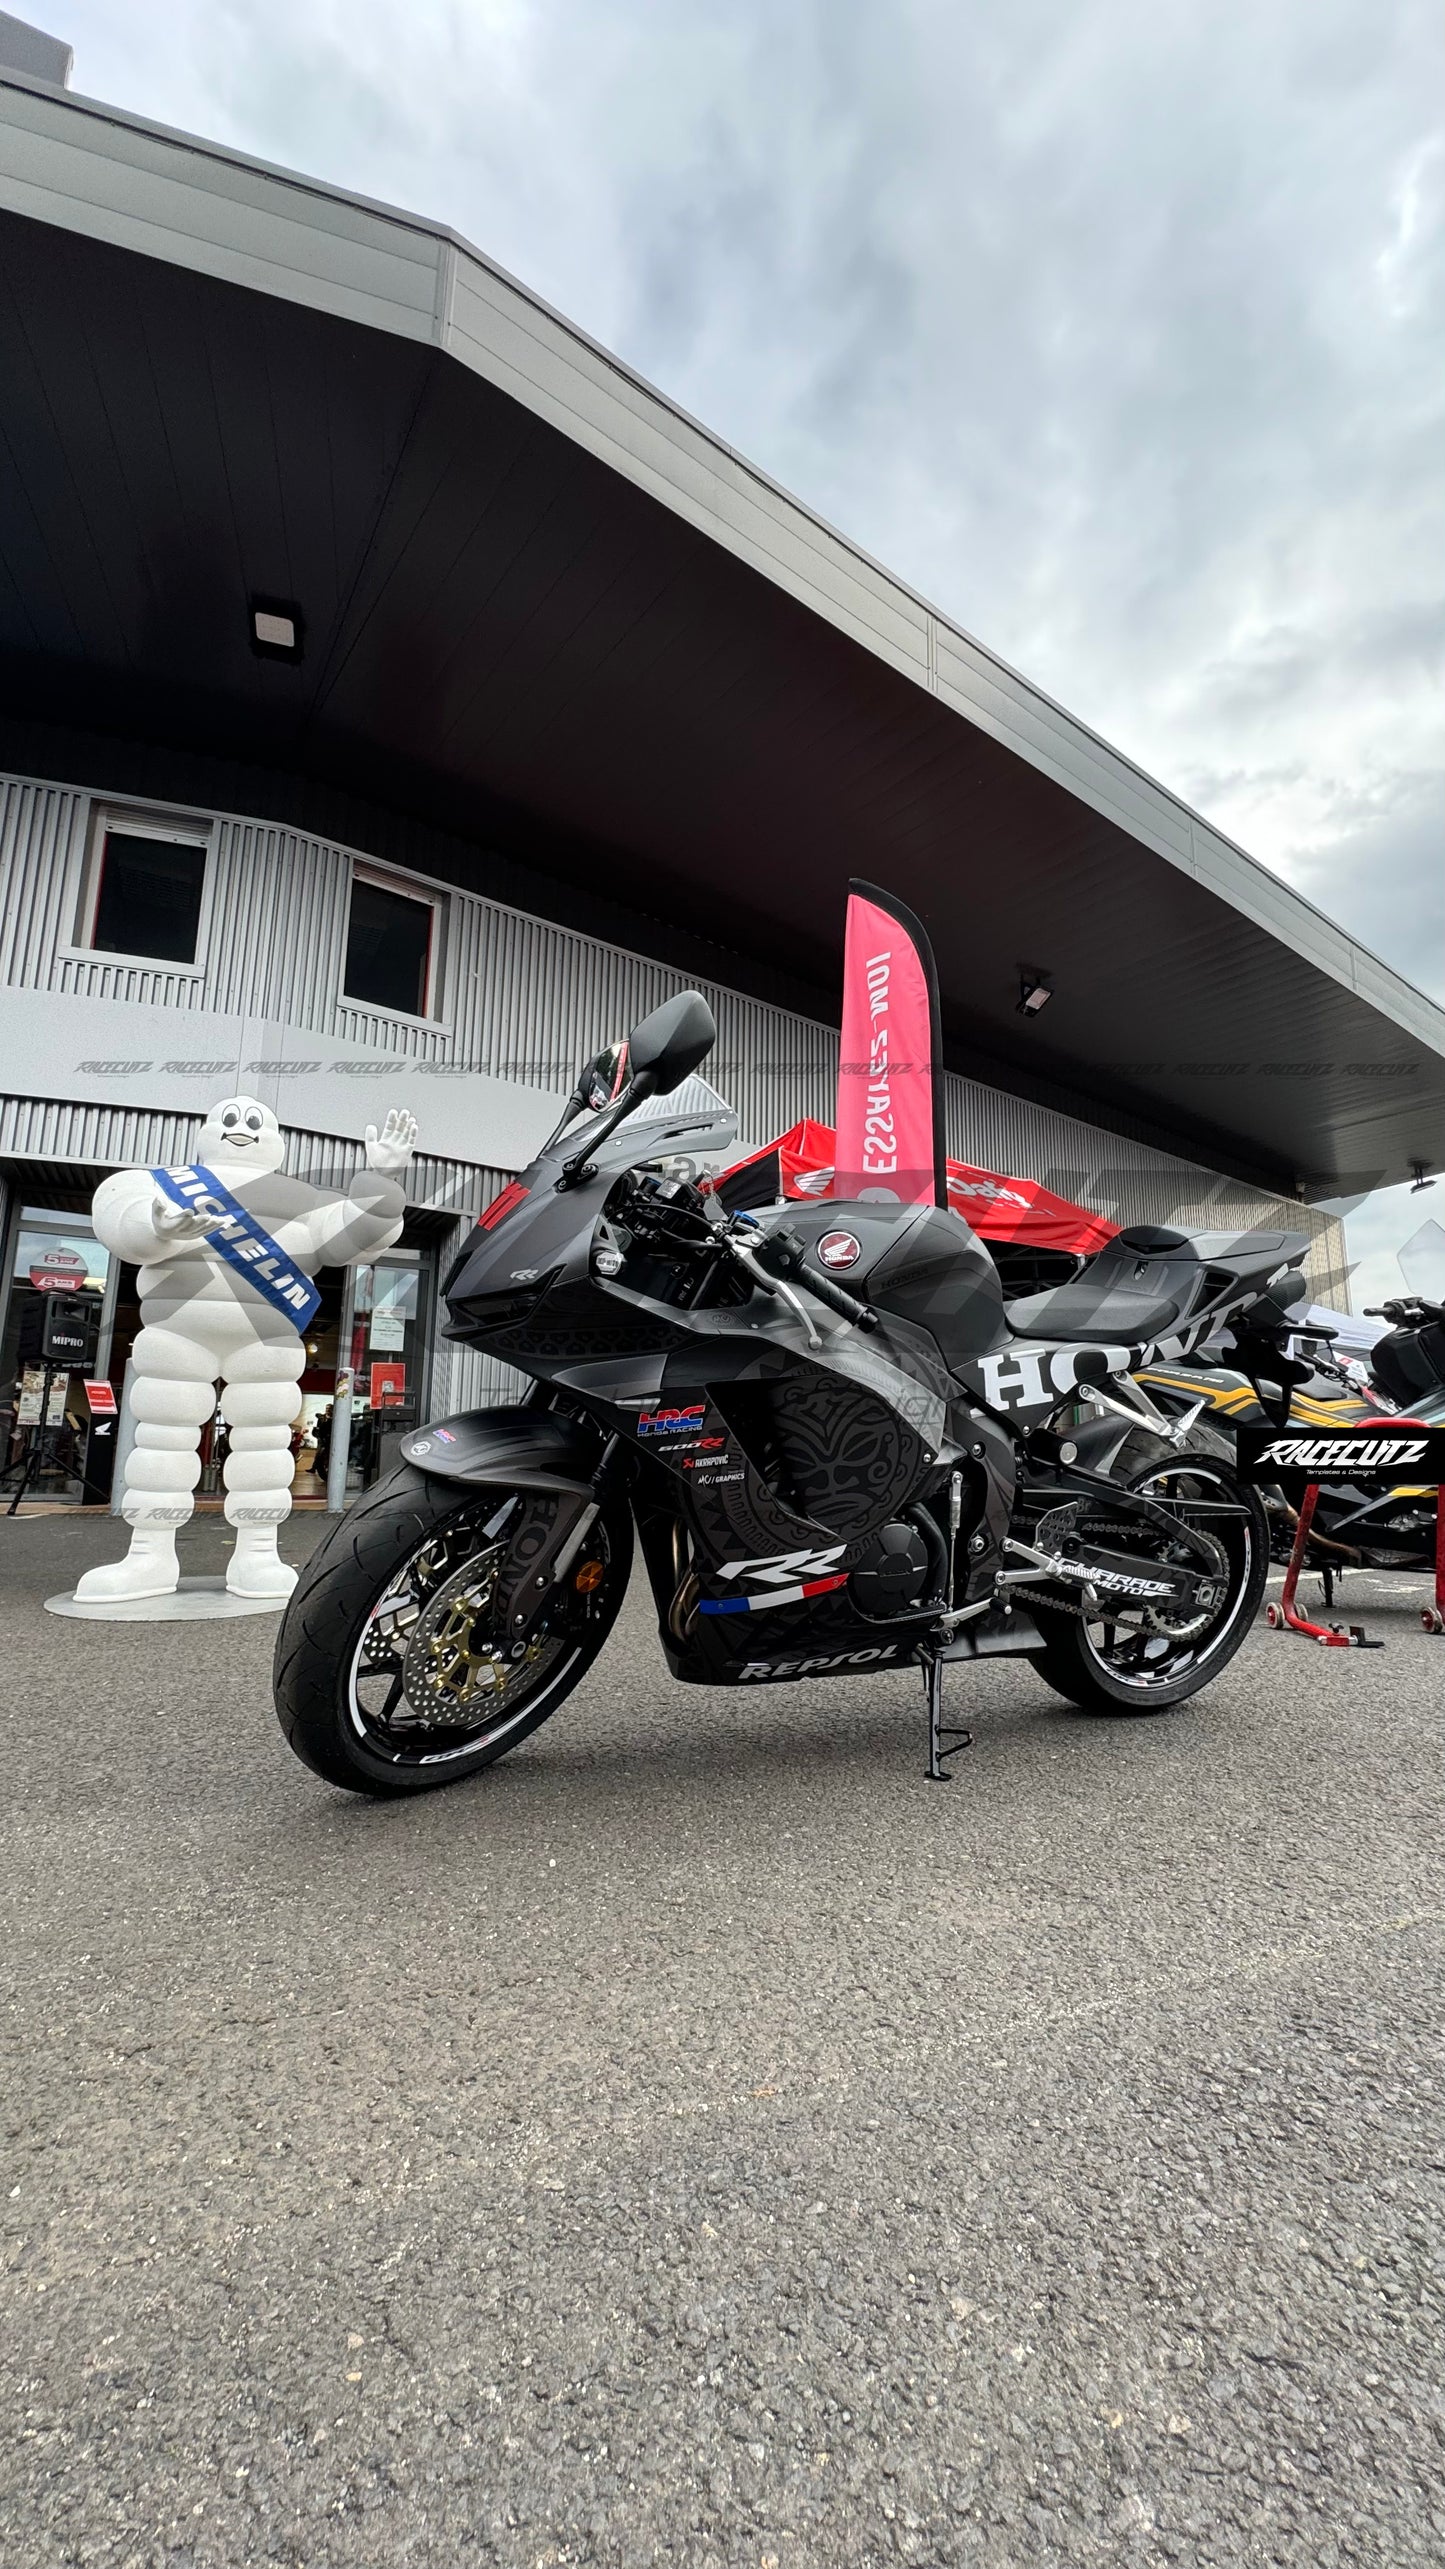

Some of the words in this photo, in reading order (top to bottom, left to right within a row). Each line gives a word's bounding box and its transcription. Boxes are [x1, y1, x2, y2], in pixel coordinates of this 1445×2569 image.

[164, 1165, 311, 1310] MICHELIN
[52, 1335, 84, 1348] MIPRO
[637, 1405, 706, 1434] HRC
[1094, 1580, 1143, 1596] MOTO
[738, 1644, 899, 1680] REPSOL
